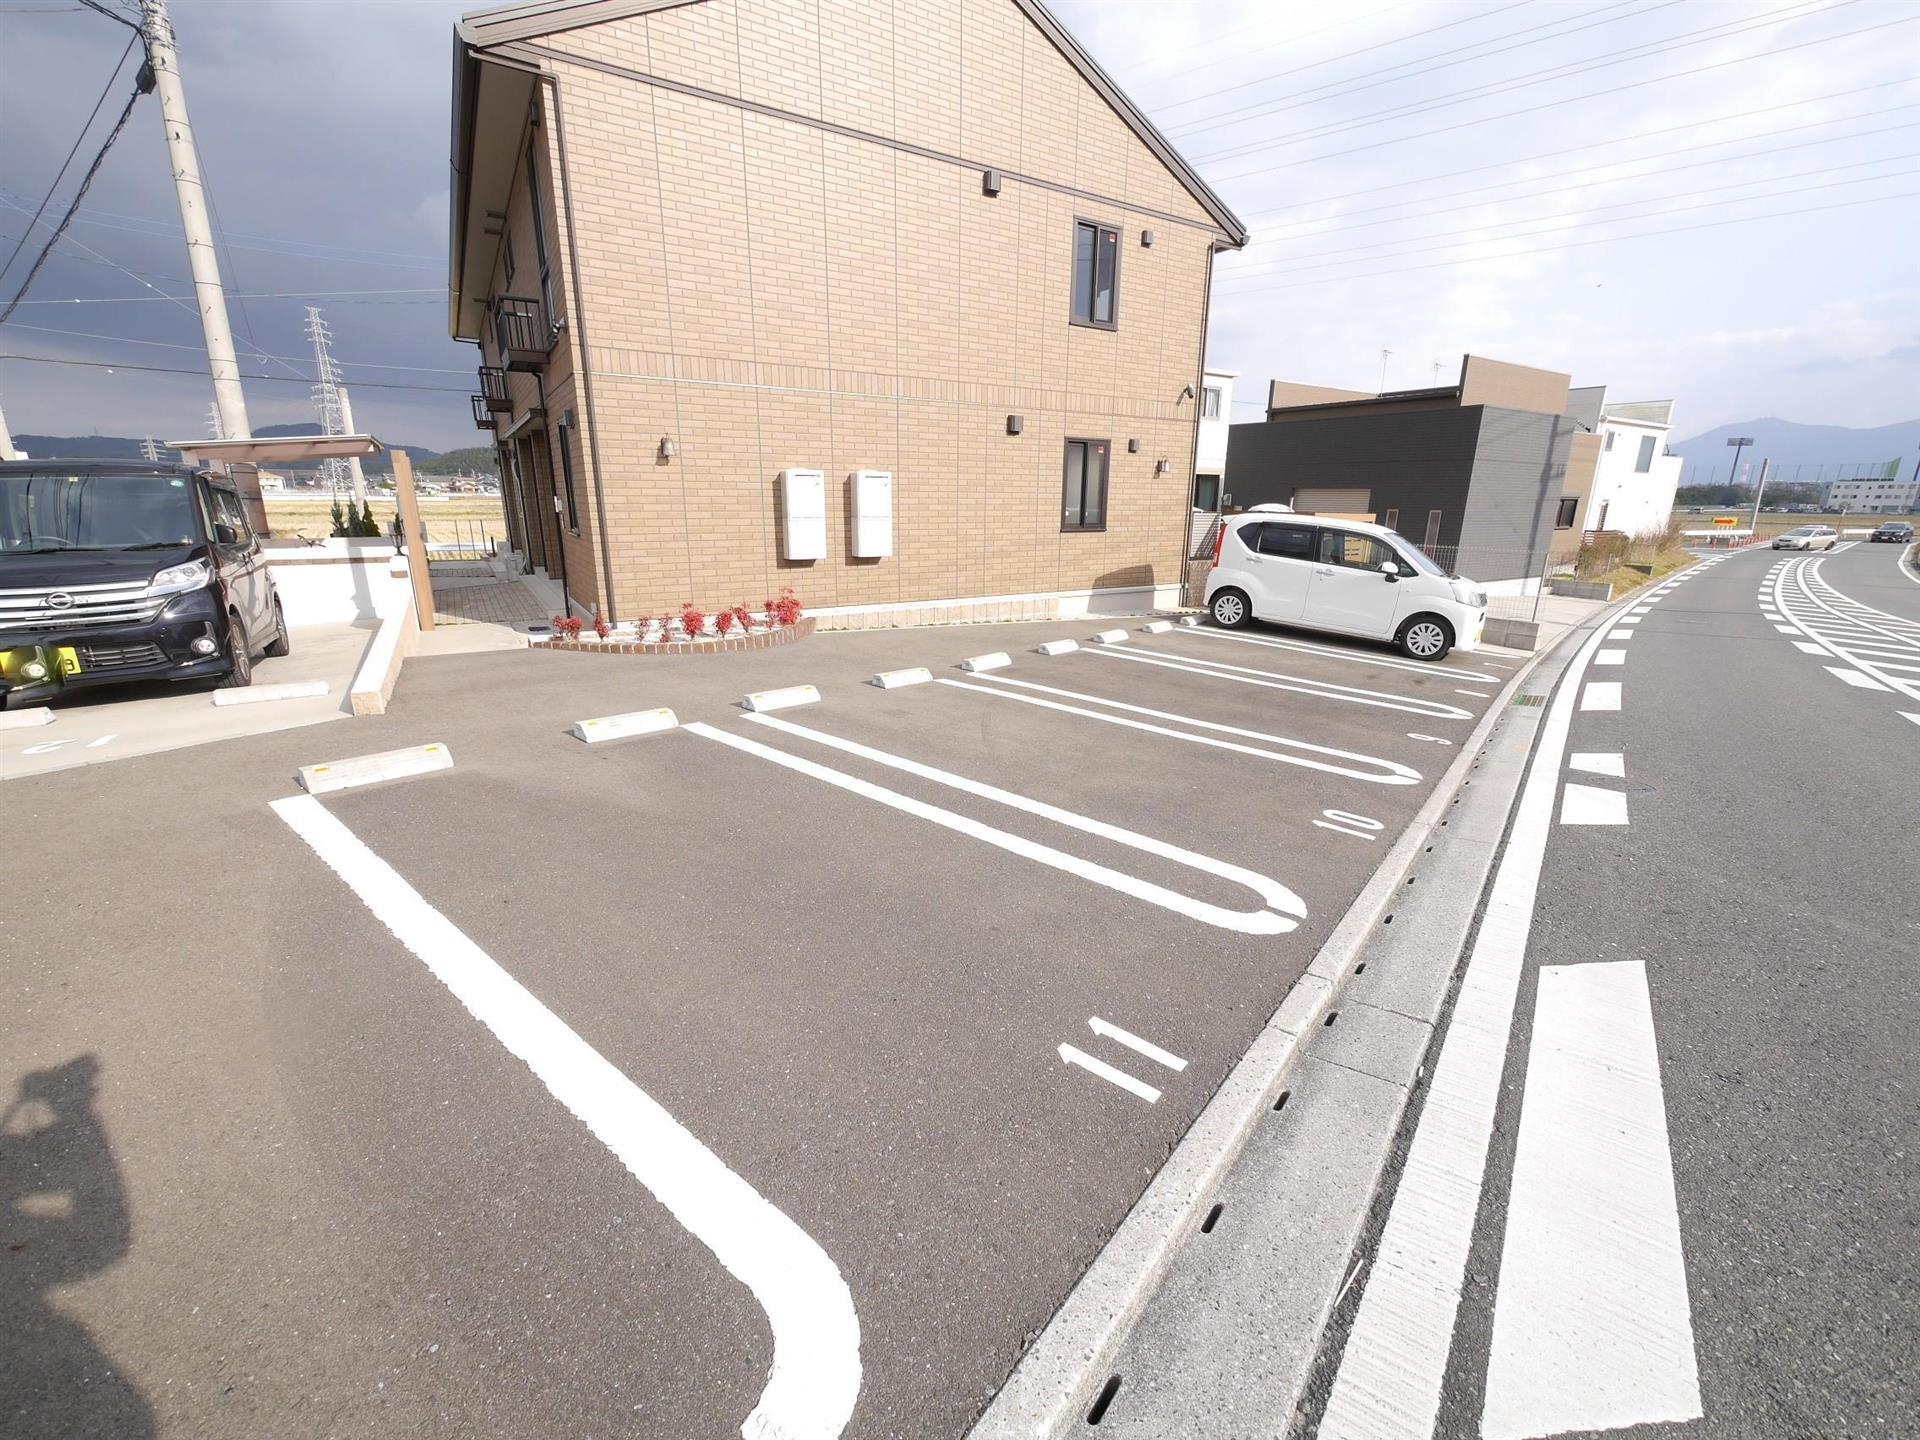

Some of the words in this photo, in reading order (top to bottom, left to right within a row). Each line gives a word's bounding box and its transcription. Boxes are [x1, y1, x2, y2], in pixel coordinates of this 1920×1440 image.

[1407, 733, 1453, 745] 9
[1312, 809, 1385, 841] 10
[1057, 1016, 1189, 1104] 11
